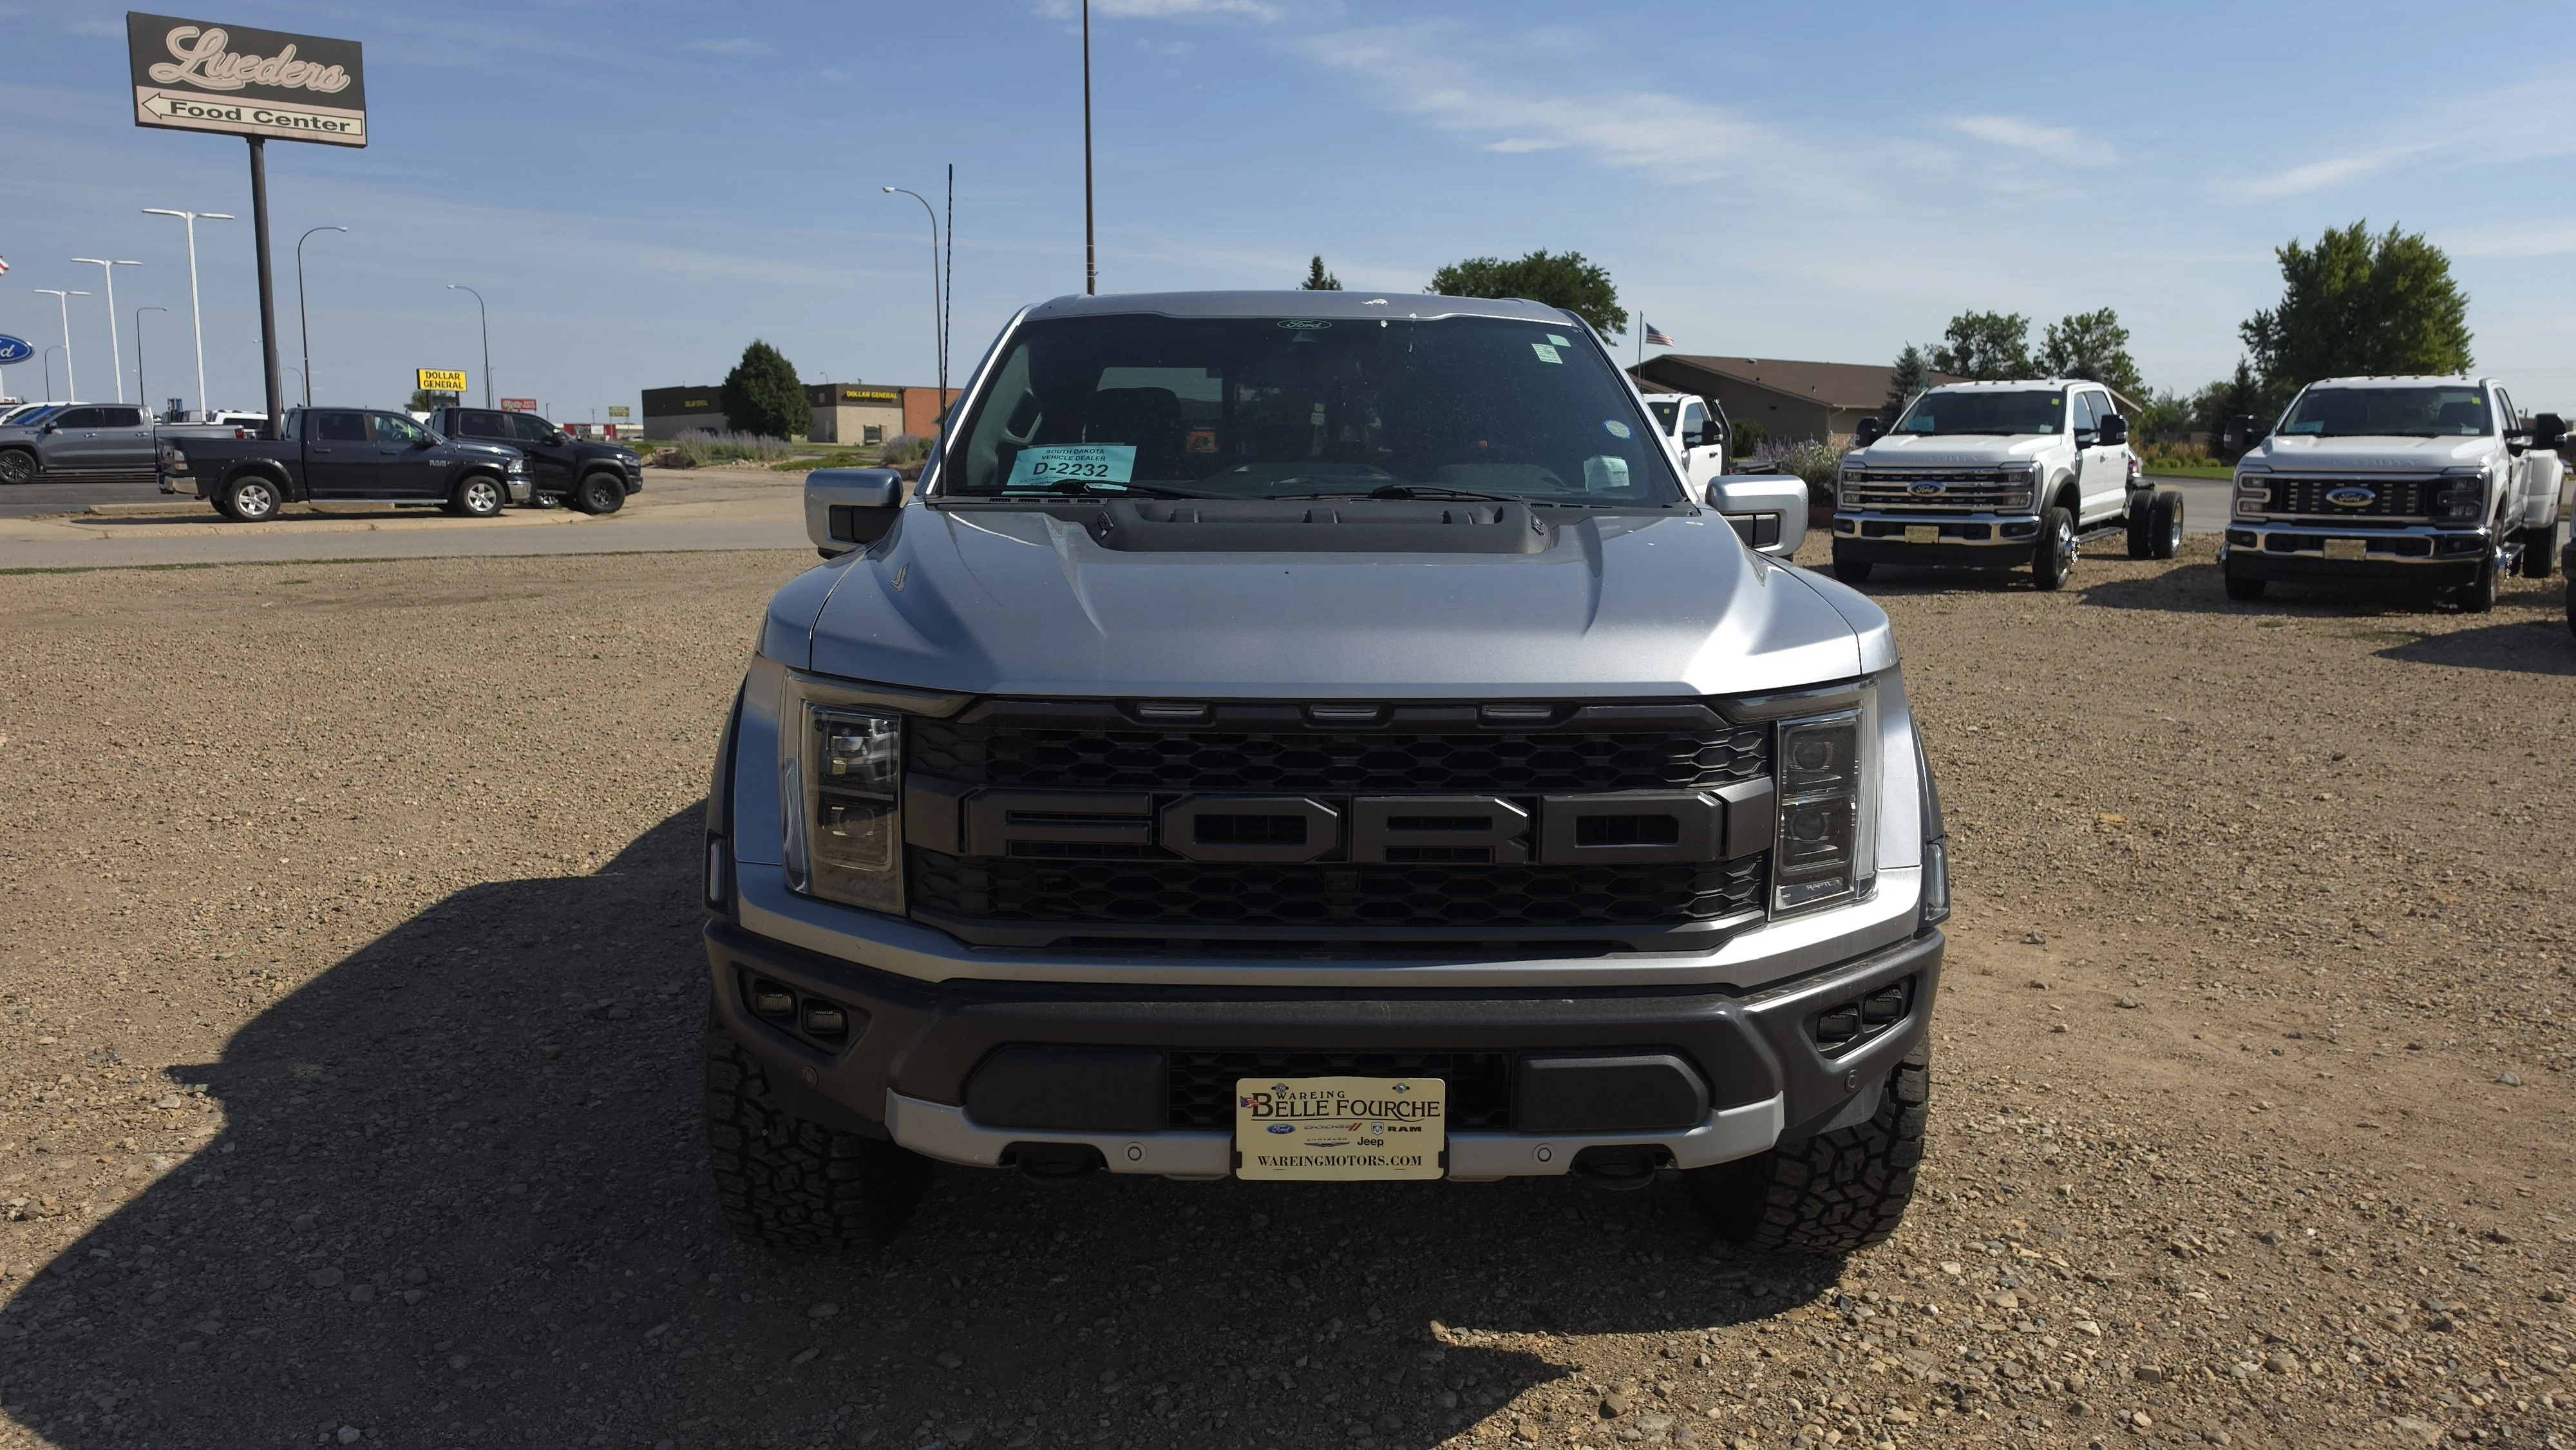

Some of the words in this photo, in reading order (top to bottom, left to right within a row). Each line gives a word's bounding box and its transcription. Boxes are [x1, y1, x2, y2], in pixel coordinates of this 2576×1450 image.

[149, 26, 351, 93] Lueders
[170, 100, 242, 122] Food
[252, 111, 351, 132] Center
[1286, 319, 1322, 328] Ford
[425, 371, 461, 381] DOLLAR
[423, 380, 462, 389] GENERAL
[871, 391, 898, 400] GENERAL
[1032, 462, 1109, 478] D-2232
[971, 793, 1723, 865] FORD
[1276, 1090, 1345, 1100] WAREING
[1251, 1092, 1329, 1117] BELLE
[1336, 1100, 1441, 1122] FOURCHE
[1357, 1136, 1385, 1147] Jeep
[1257, 1155, 1423, 1167] WAREINGMOTORS.COM
